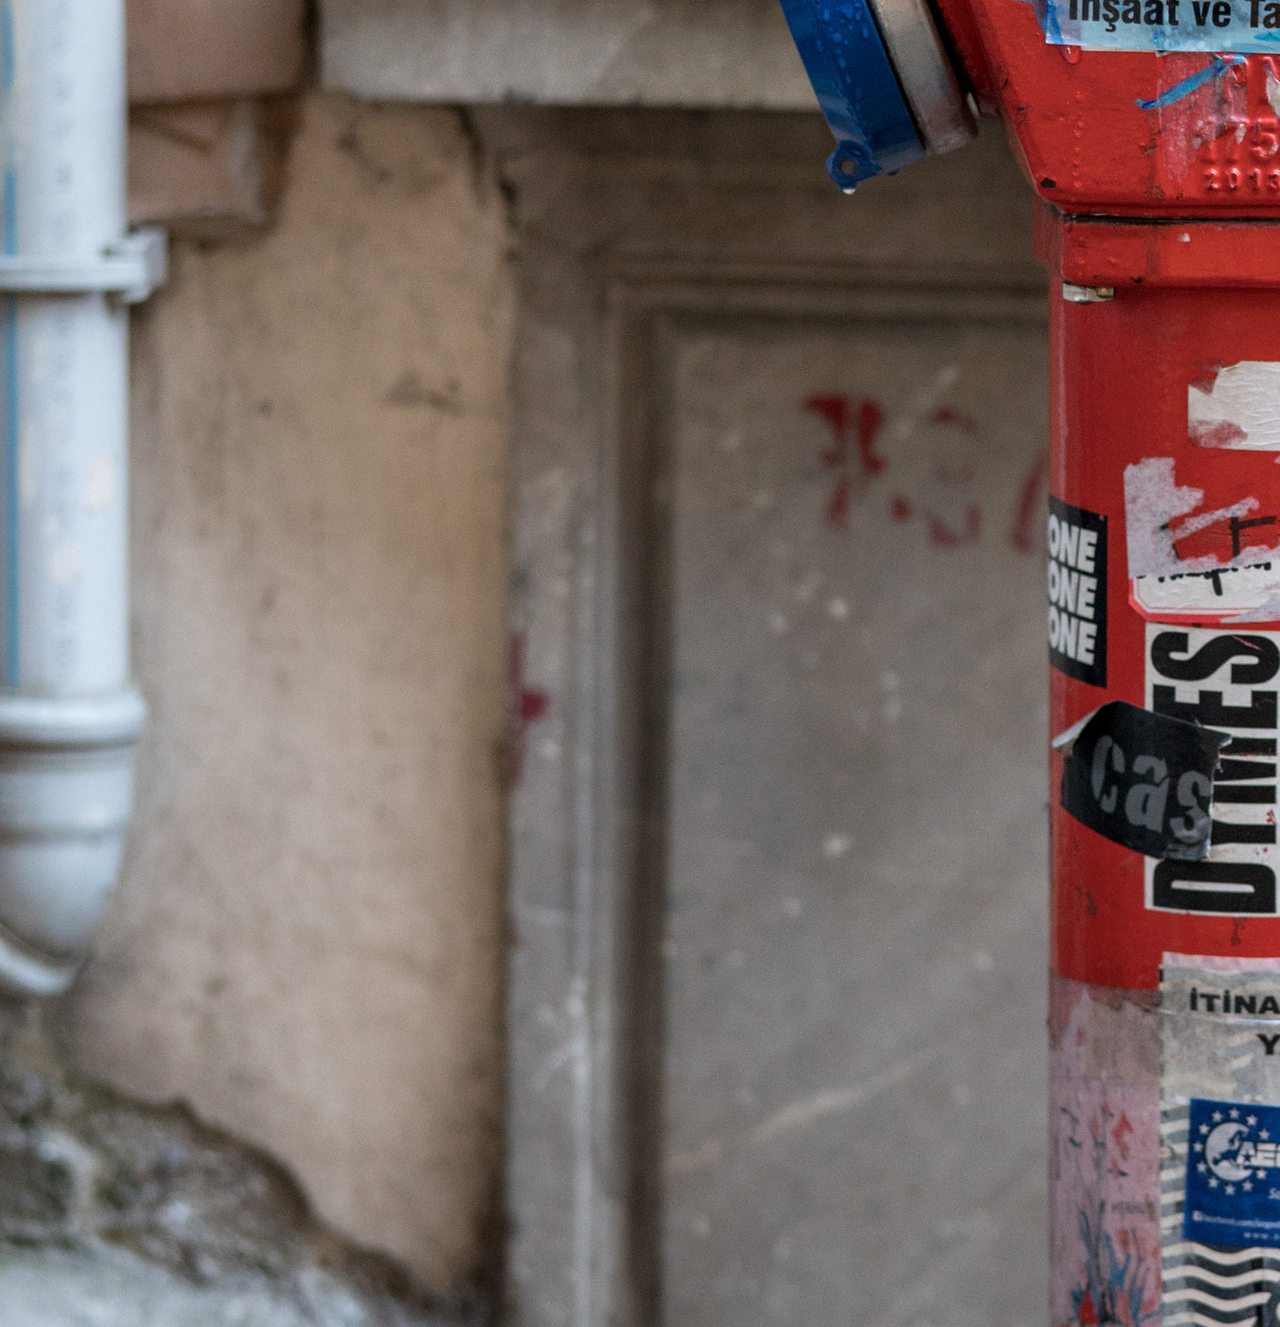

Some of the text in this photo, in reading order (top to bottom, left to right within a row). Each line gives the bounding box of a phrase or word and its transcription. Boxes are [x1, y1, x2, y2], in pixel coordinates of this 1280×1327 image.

[1192, 0, 1231, 28] ve
[1049, 513, 1098, 574] ONE
[1048, 558, 1098, 620] ONE
[1049, 604, 1098, 666] ONE
